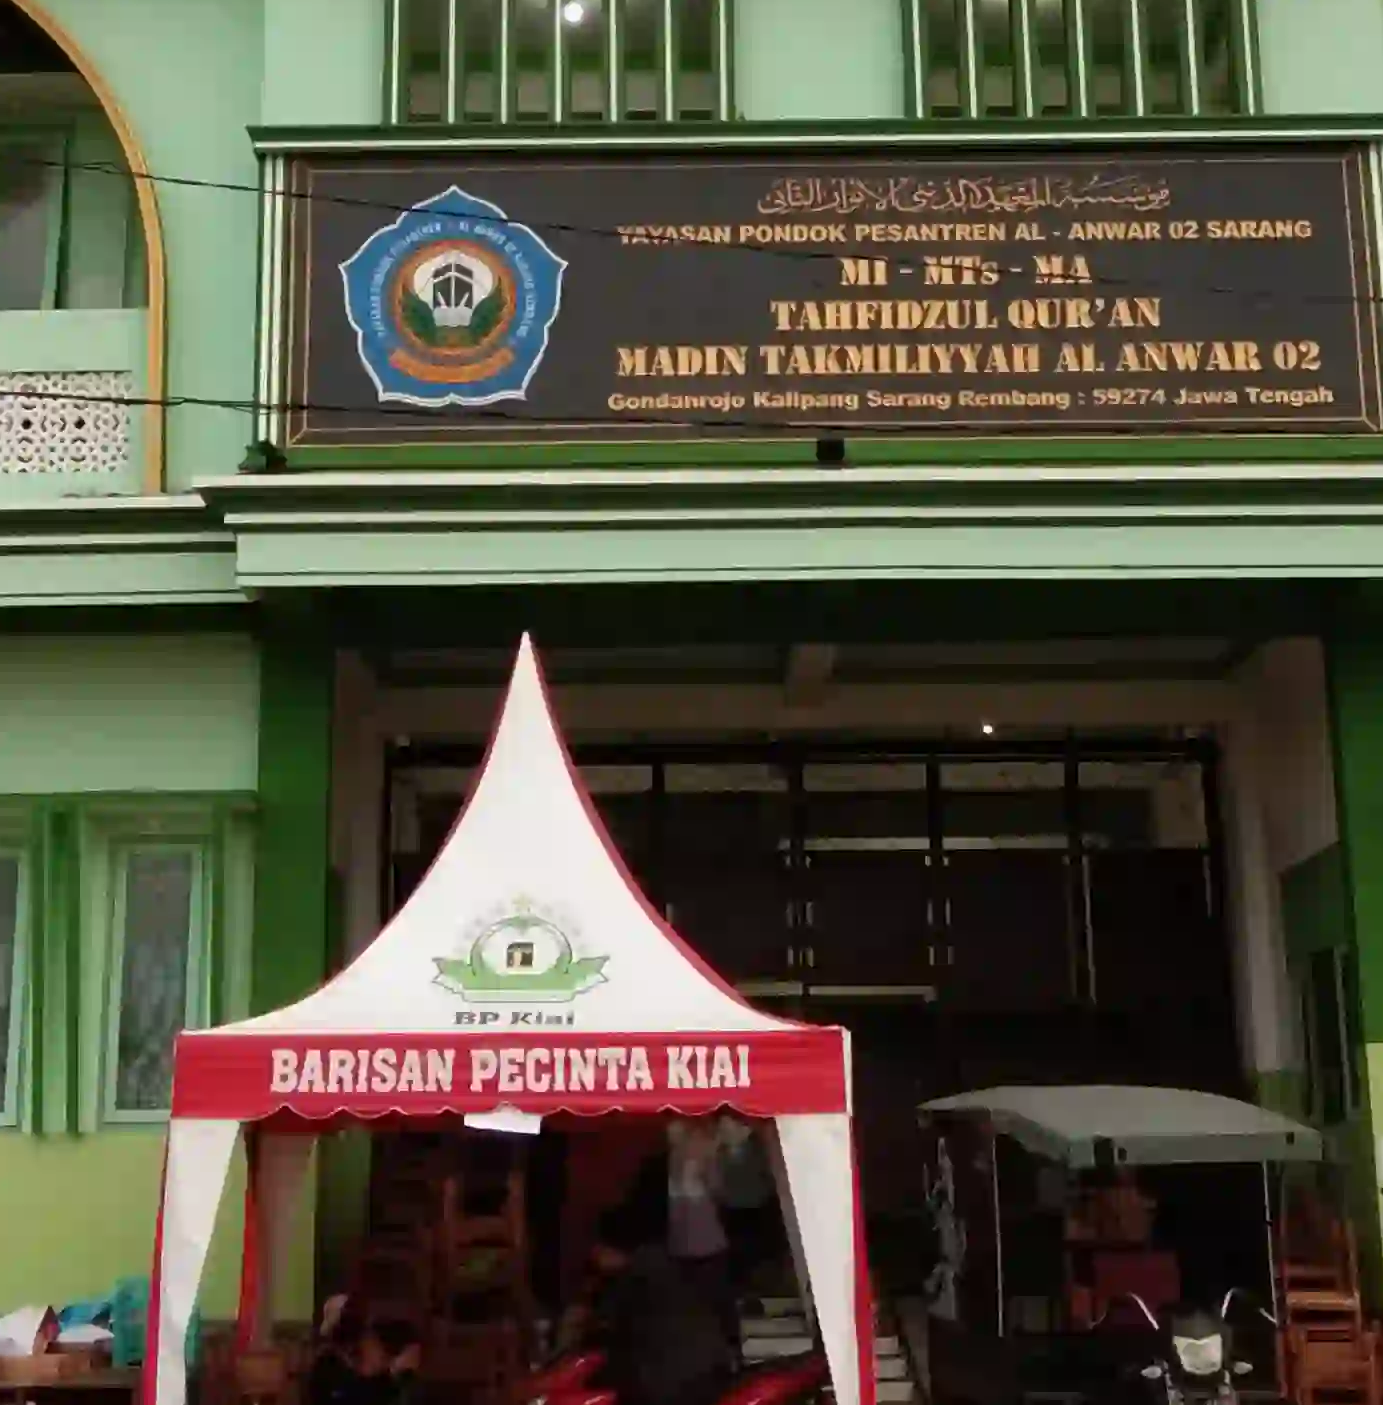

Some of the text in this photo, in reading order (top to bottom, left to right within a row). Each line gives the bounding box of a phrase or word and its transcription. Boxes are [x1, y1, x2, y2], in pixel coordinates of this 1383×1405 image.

[615, 224, 732, 245] YAYASAN
[739, 224, 847, 244] PONDOK
[855, 222, 1007, 243] PESANTREN
[1014, 222, 1046, 242] AL
[1068, 221, 1163, 241] ANWAR
[1168, 220, 1201, 240] 02
[1207, 219, 1314, 239] SARANG
[839, 255, 889, 286] MI
[923, 255, 1001, 286] MTs
[1031, 255, 1094, 285] MA
[769, 298, 999, 331] TAHFIDZUL
[615, 339, 1322, 377] MADIN TAKMILIYYAH AL ANWAR 02
[752, 390, 860, 412] Kalipang
[866, 389, 952, 411] Sarang
[957, 388, 1071, 411] Rembang
[1091, 387, 1167, 407] 59274
[1173, 387, 1239, 407] Jawa
[1244, 384, 1335, 408] Tengah
[453, 1010, 500, 1025] BP
[269, 1044, 751, 1094] BARISAN PECINTA KIAI
